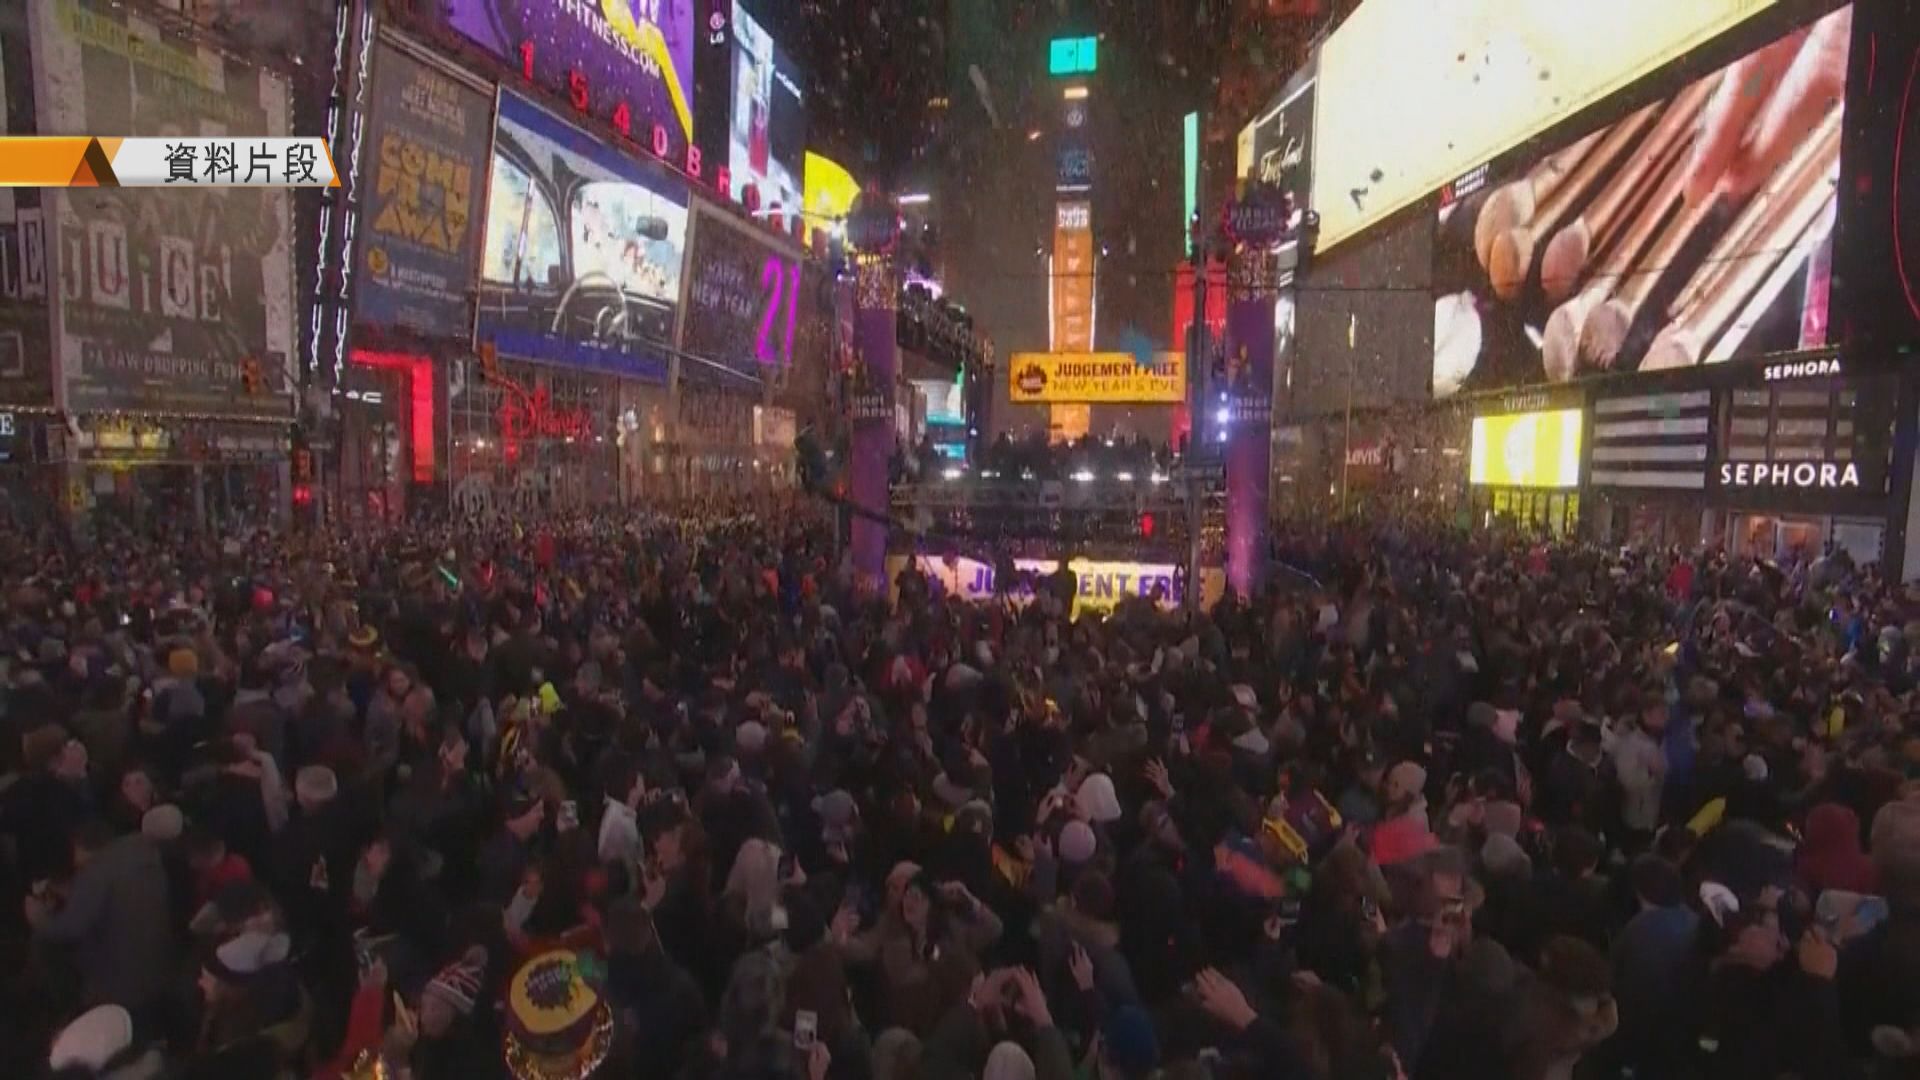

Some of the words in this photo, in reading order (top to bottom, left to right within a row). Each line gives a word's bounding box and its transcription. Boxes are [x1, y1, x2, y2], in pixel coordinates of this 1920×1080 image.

[755, 252, 801, 368] 21
[1054, 362, 1139, 377] JUDGEMENT
[1764, 359, 1841, 381] SEPHORA
[1720, 463, 1859, 487] SEPHORA
